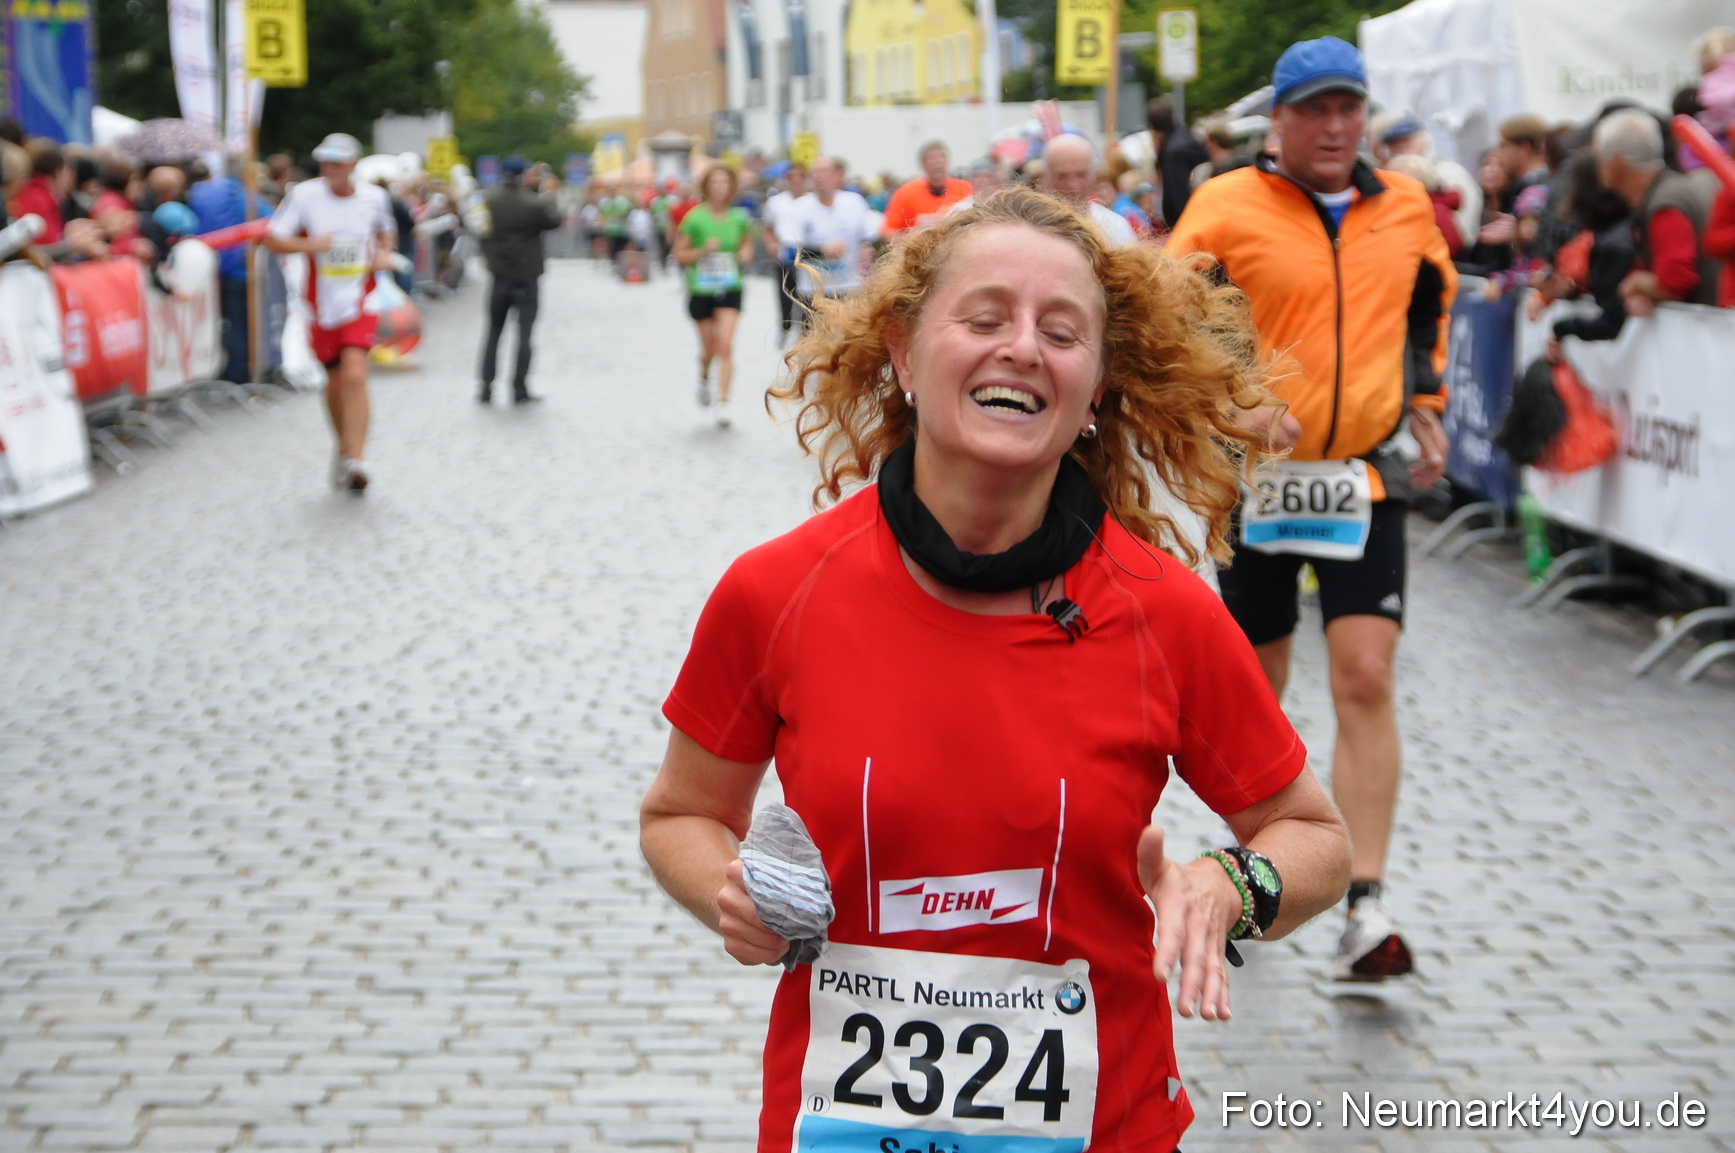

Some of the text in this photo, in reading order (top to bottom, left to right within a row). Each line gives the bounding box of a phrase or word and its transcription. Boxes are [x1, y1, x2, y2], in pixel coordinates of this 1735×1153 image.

[257, 20, 283, 59] B
[1075, 19, 1103, 59] B
[1257, 479, 1357, 515] 2602
[921, 888, 996, 915] DEHN
[818, 969, 1045, 1010] PARTL Neumarkt
[833, 1013, 1070, 1122] 2324
[812, 1096, 824, 1112] D
